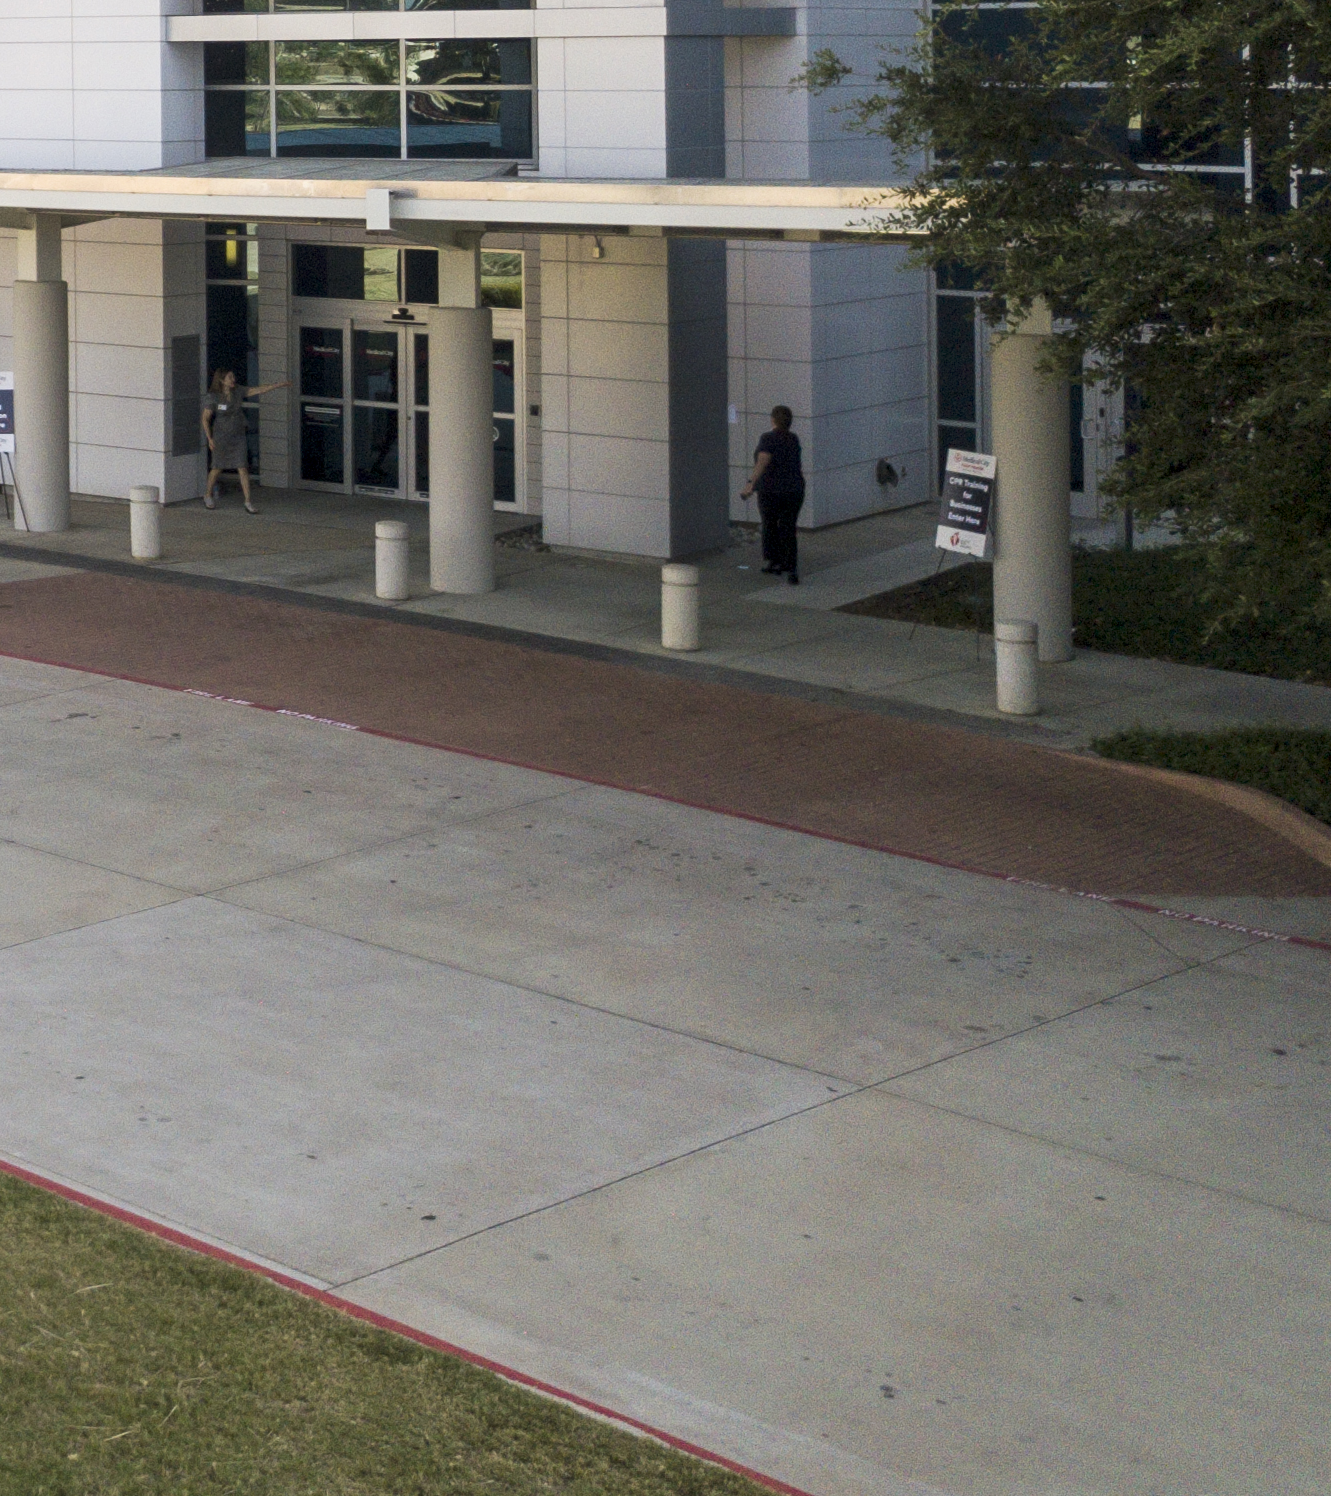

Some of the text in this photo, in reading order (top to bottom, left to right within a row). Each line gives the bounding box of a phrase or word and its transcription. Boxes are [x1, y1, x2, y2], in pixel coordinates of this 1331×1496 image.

[949, 476, 989, 493] CPR Training
[963, 490, 973, 499] for
[949, 499, 982, 513] Businesses
[948, 511, 980, 525] Enter Here
